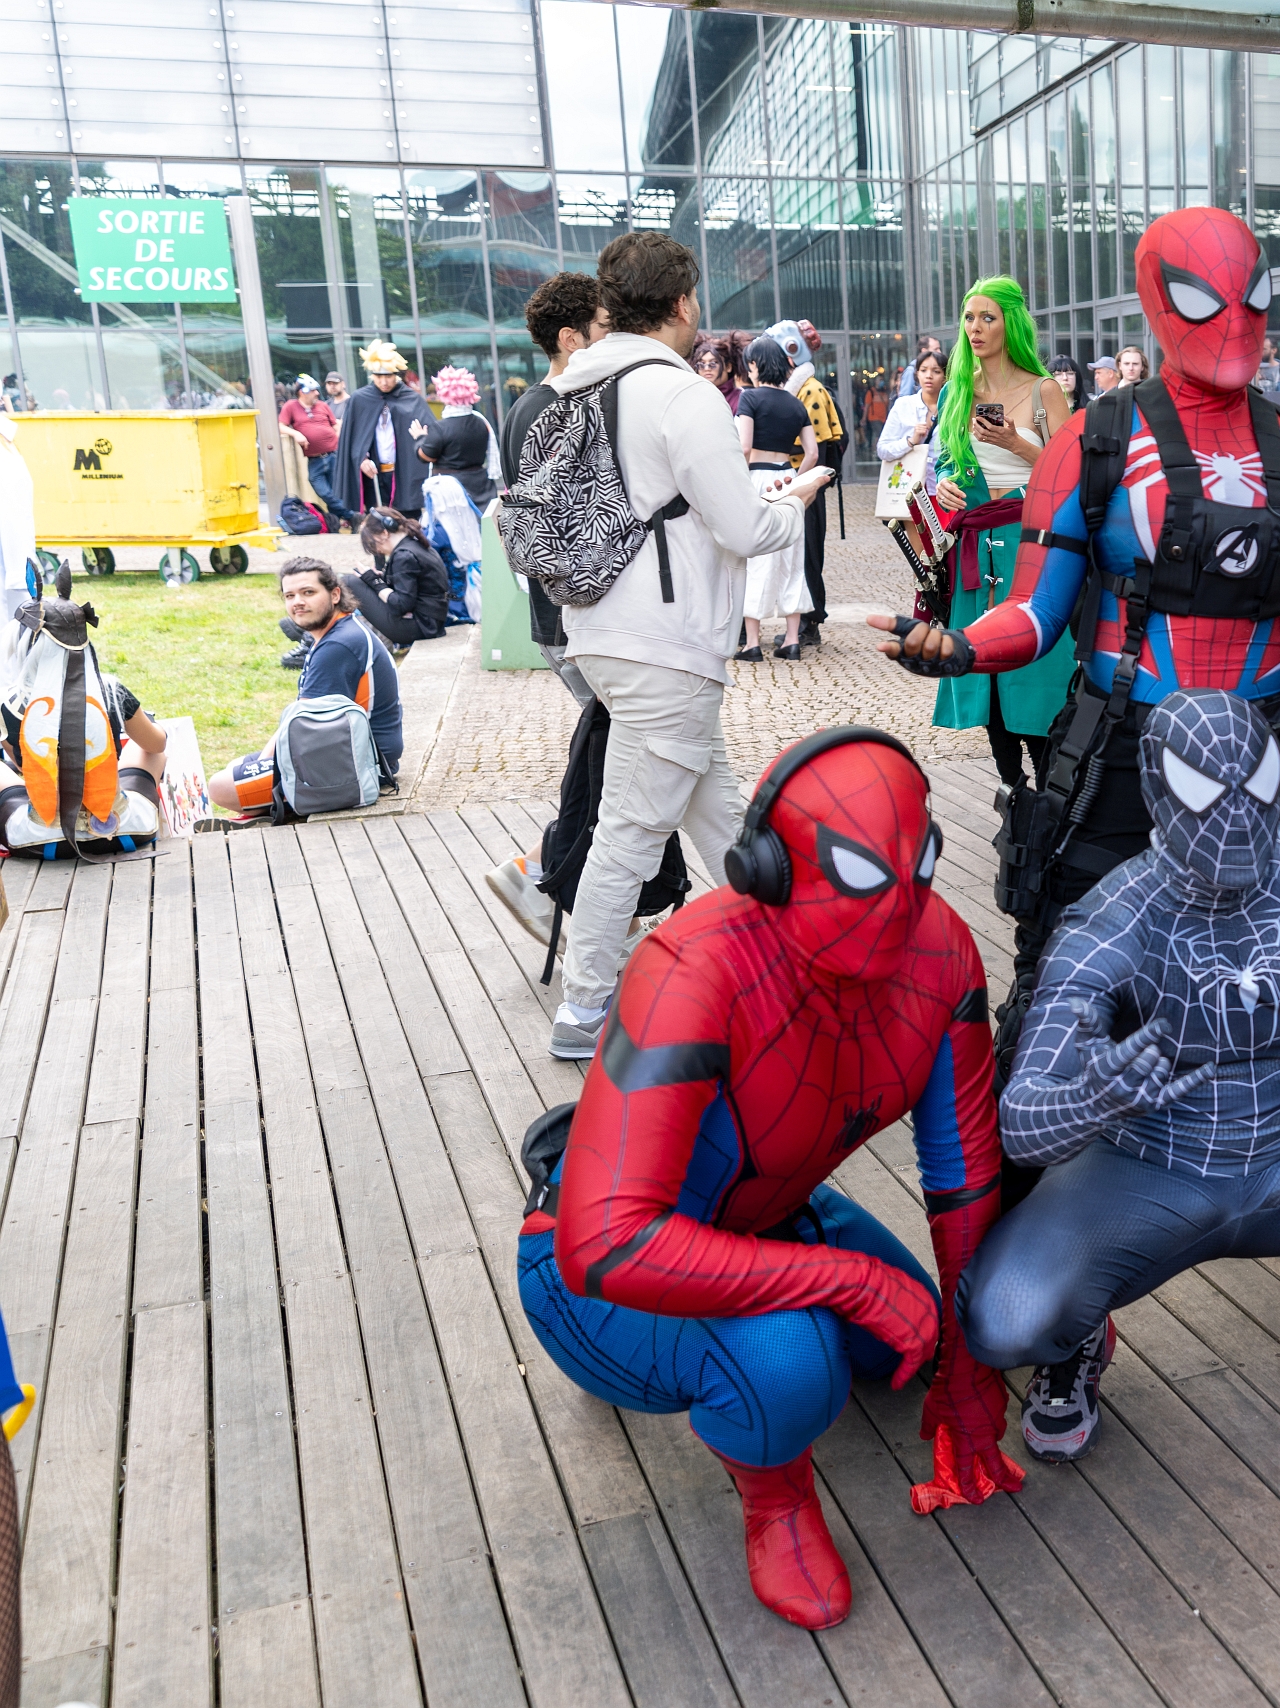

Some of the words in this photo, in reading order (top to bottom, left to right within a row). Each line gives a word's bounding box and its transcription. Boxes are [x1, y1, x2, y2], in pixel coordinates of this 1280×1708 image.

[96, 209, 205, 234] SORTIE
[134, 238, 175, 263] DE
[87, 266, 230, 291] SECOURS
